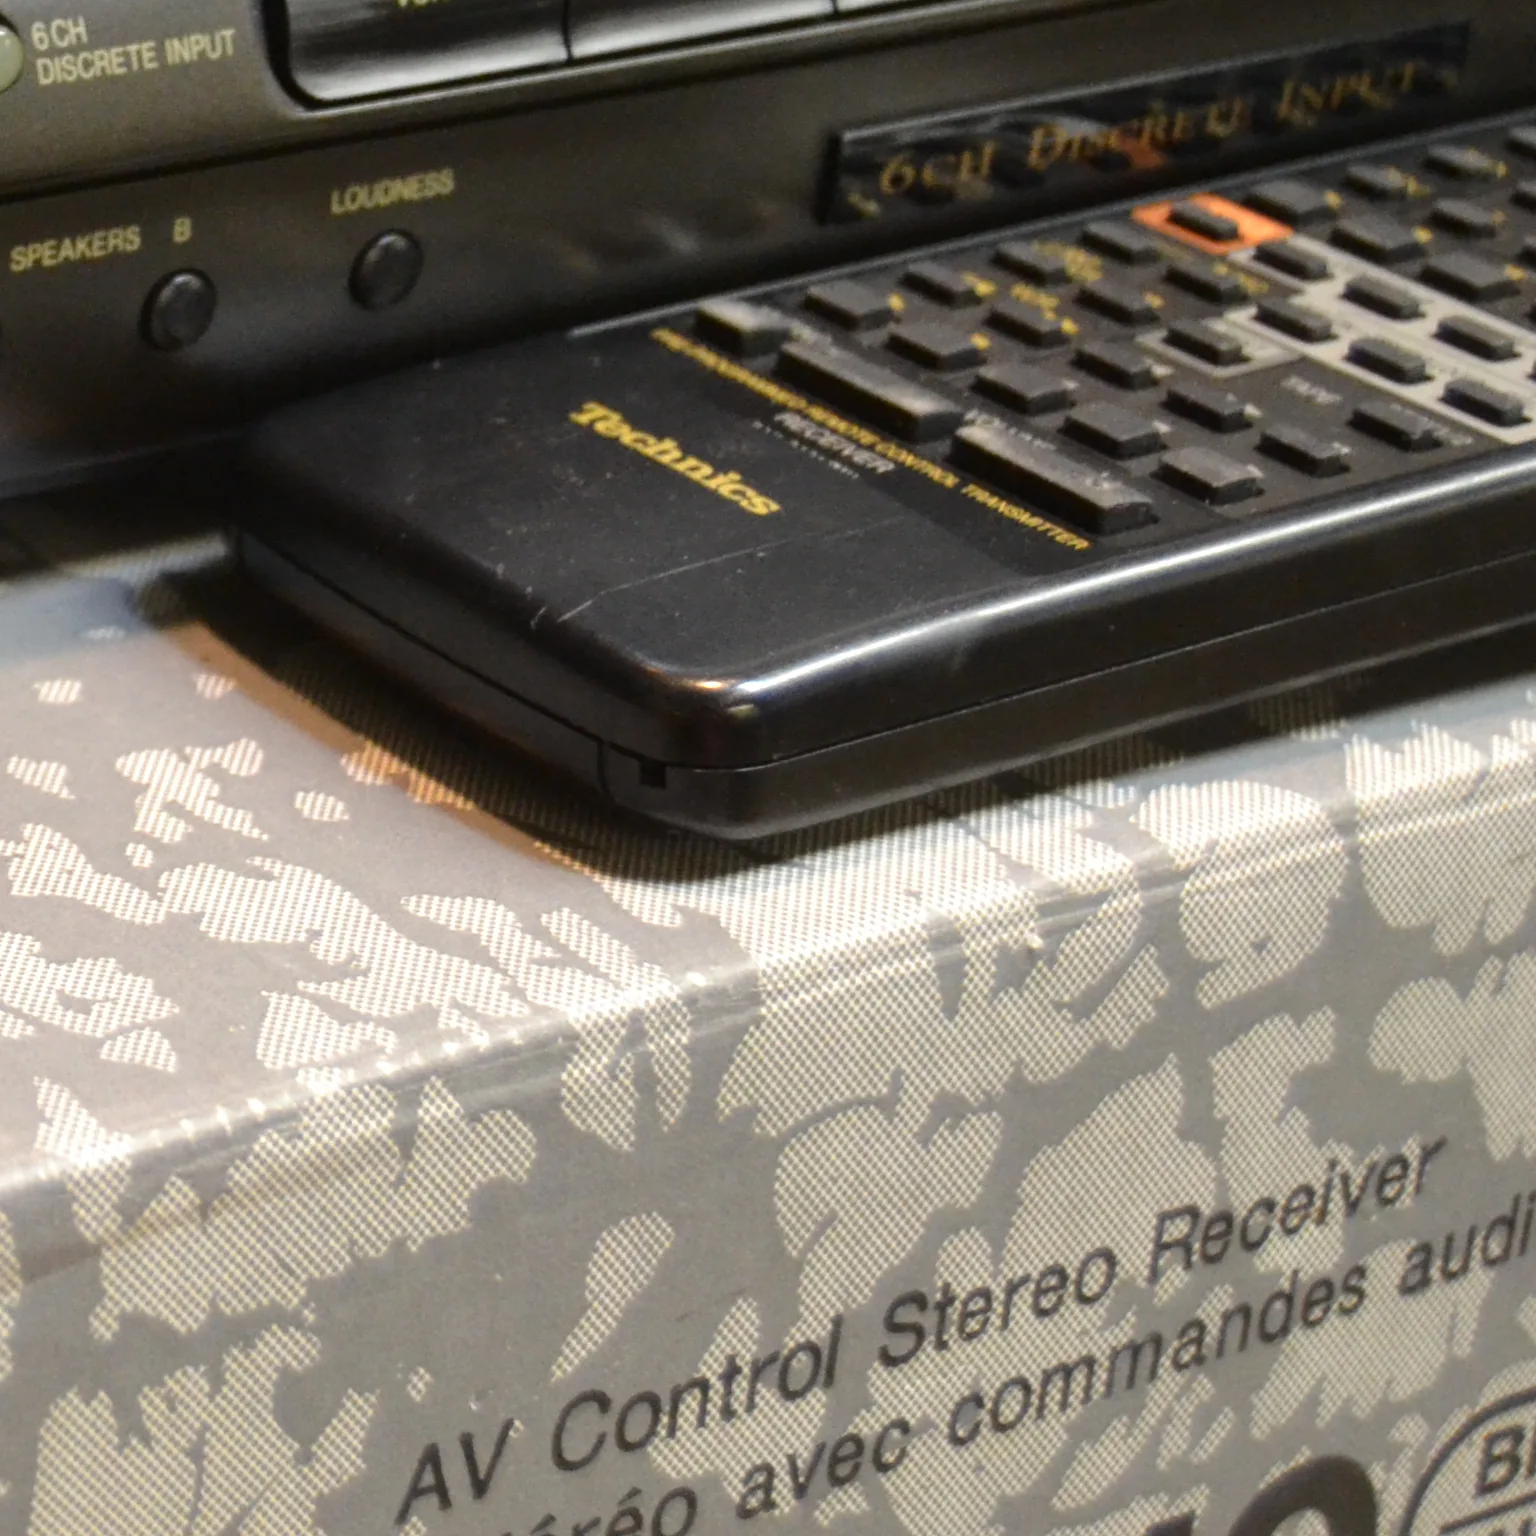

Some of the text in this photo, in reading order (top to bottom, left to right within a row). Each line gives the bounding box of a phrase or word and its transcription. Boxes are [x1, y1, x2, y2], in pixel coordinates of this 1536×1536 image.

[35, 27, 236, 86] DISCRETE INPUT
[330, 167, 456, 216] LOUDNESS
[9, 225, 143, 273] SPEAKERS
[172, 216, 193, 244] B
[569, 401, 781, 517] Technics
[393, 1134, 1450, 1527] AV Control Stereo Receiver
[736, 1419, 912, 1518] avec
[944, 1264, 1368, 1449] commandes
